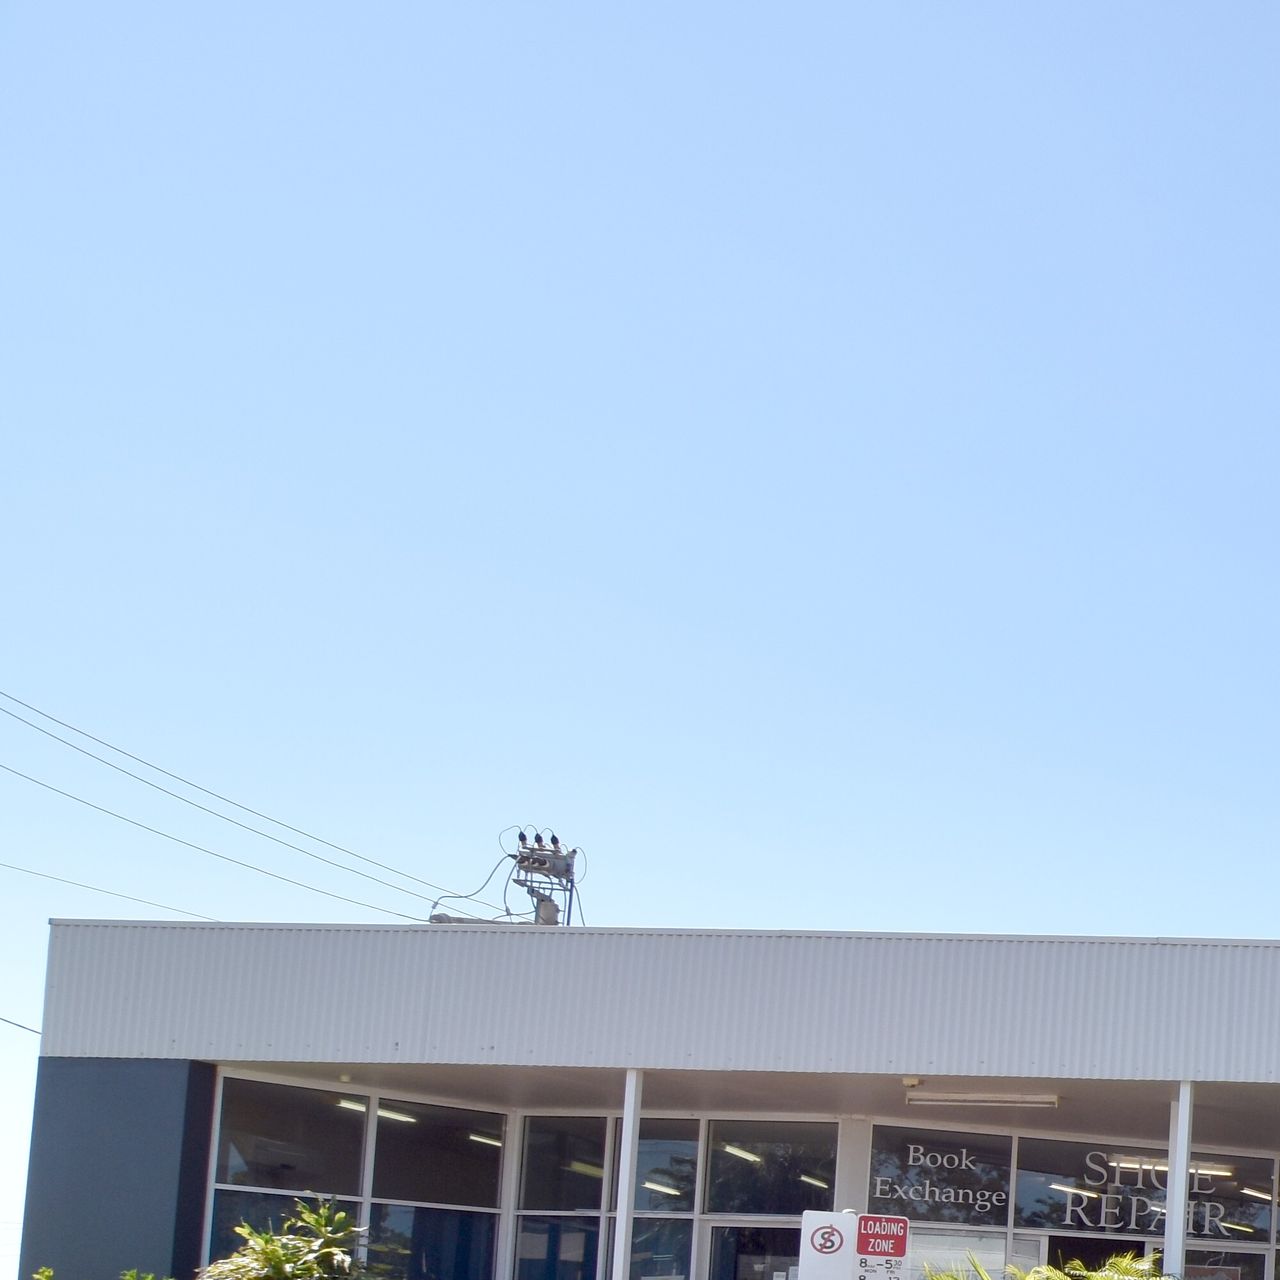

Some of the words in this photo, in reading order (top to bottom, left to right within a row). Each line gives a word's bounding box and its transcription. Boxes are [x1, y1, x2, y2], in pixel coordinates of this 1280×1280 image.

[907, 1144, 977, 1170] Book
[873, 1176, 1007, 1212] Exchange
[861, 1220, 904, 1236] LOADING
[868, 1239, 895, 1253] ZONE
